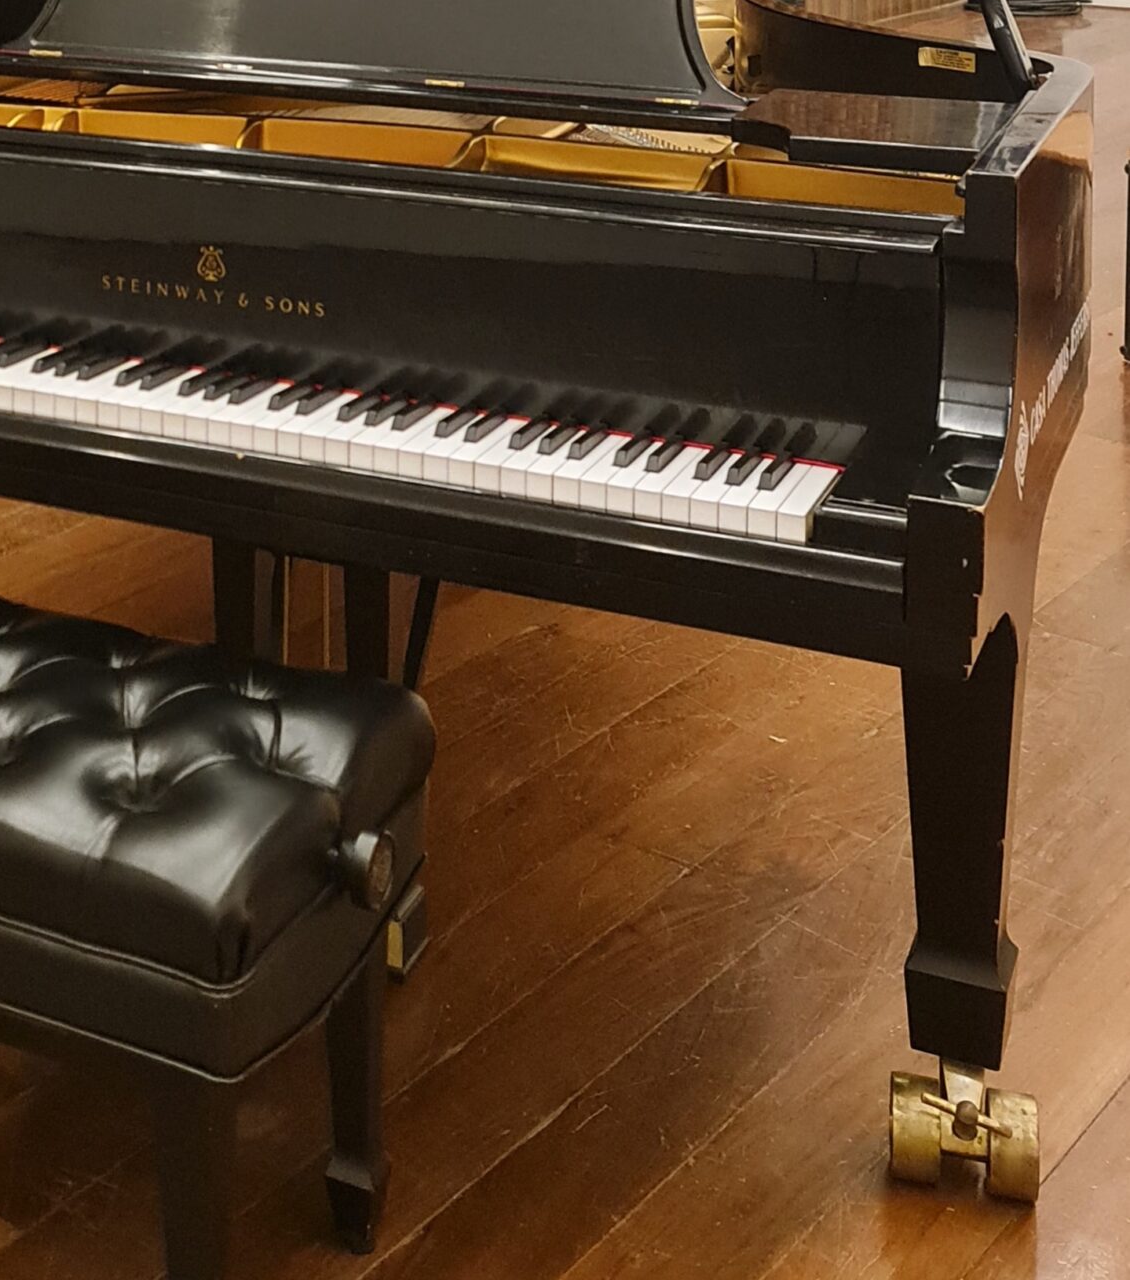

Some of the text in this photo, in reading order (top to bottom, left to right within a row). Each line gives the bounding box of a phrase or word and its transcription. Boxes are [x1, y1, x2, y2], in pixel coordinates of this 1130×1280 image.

[102, 275, 325, 317] STEINWAY & SONS
